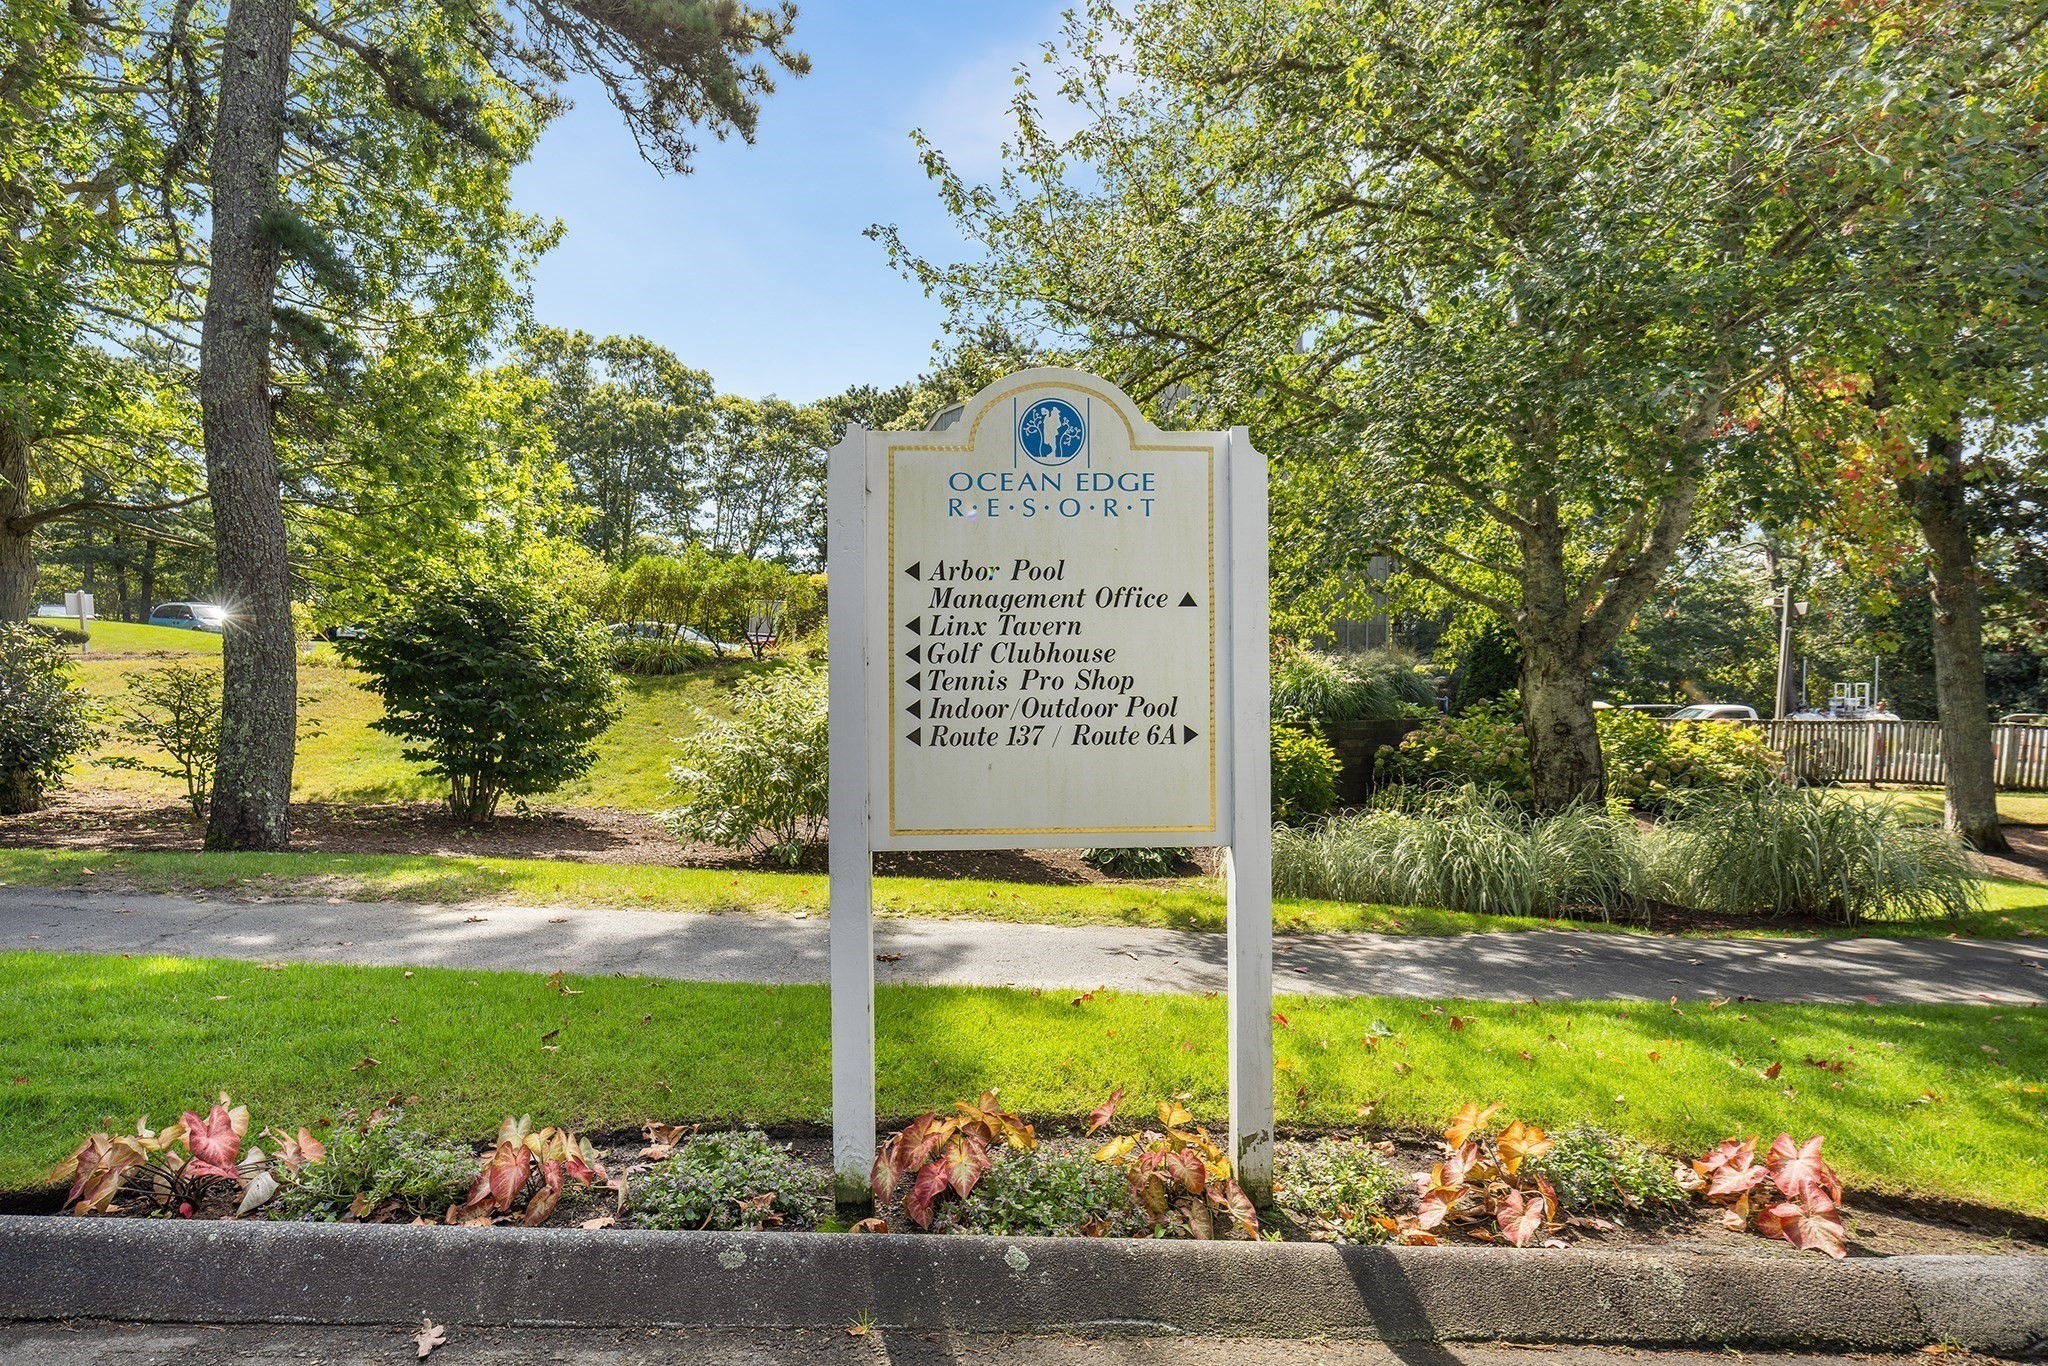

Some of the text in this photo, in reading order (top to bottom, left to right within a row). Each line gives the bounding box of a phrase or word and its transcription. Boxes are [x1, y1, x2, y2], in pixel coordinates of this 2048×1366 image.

[949, 472, 1154, 491] OCEAN EDGE
[928, 559, 1065, 581] Arbor Pool
[928, 586, 1168, 613] Management Office
[928, 615, 1082, 636] Linx Tavern
[927, 642, 1115, 664] Golf Clubhouse
[928, 669, 1134, 695] Tennis Pro Shop
[1125, 696, 1178, 717] Pool
[929, 725, 998, 747] Route
[1006, 725, 1045, 746] 137
[1071, 724, 1139, 745] Route
[1147, 724, 1176, 745] 6A
